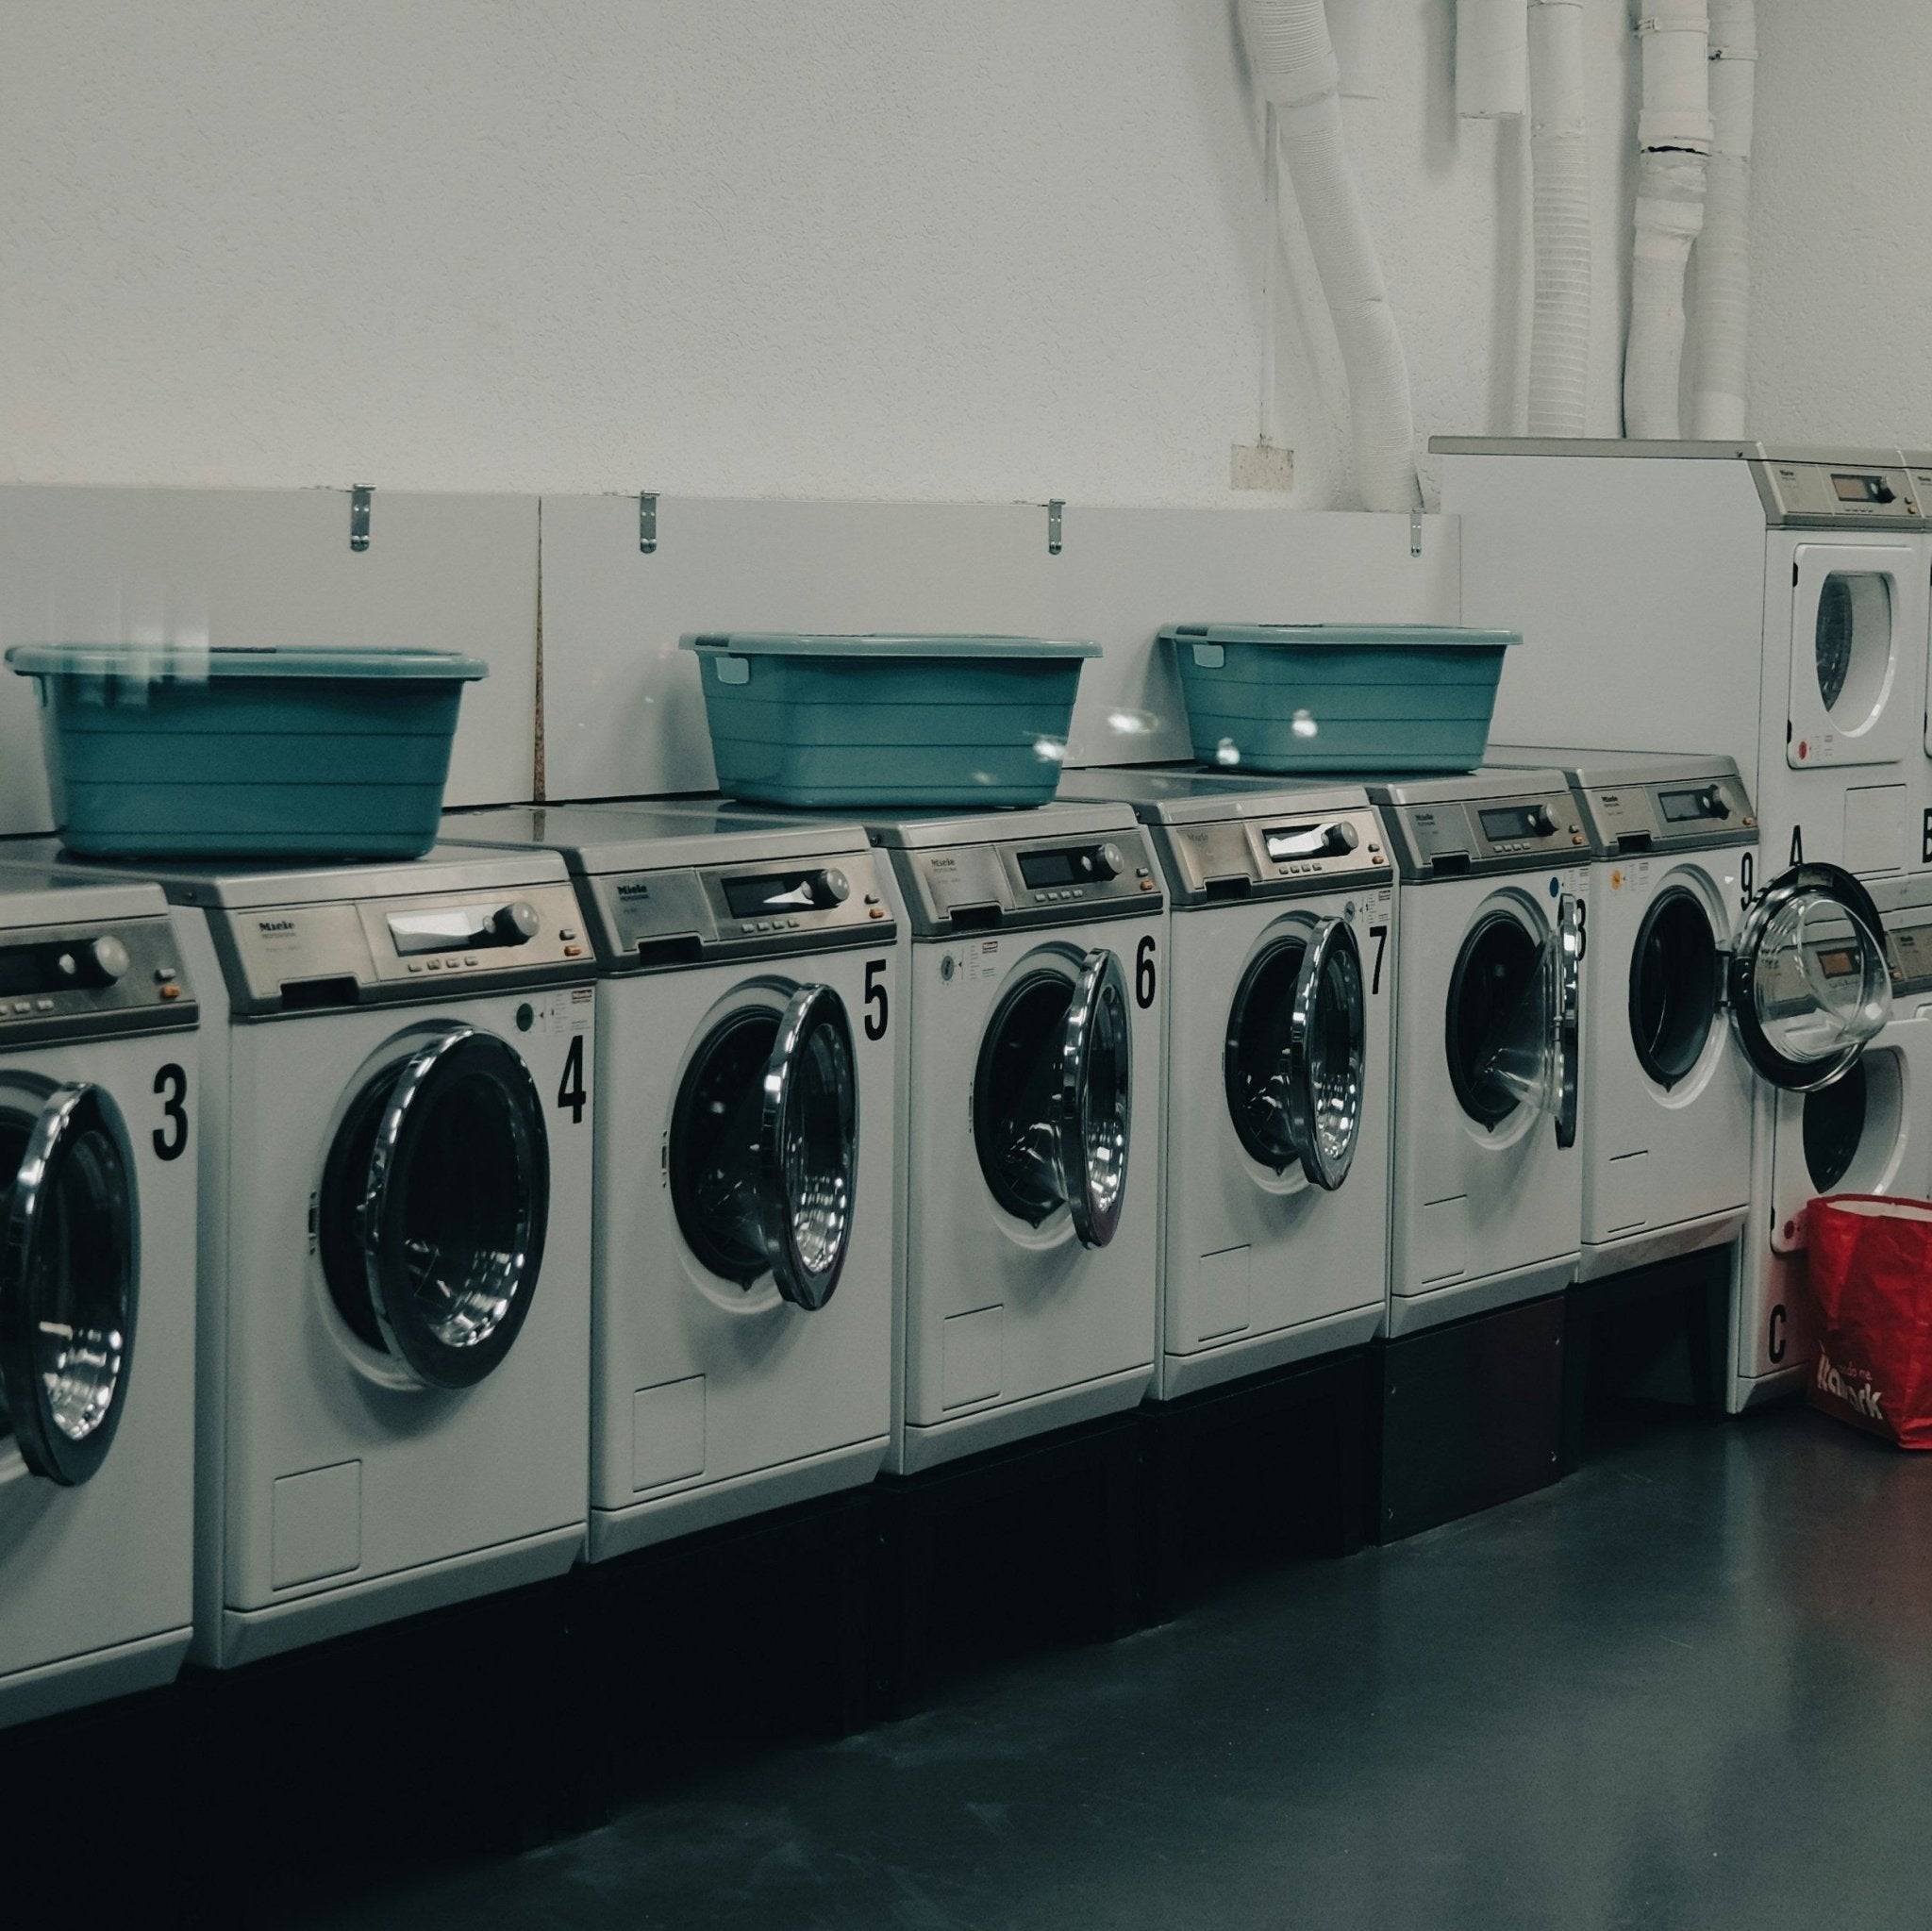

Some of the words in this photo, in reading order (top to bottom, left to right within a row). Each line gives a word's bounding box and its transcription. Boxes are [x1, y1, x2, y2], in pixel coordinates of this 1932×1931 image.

[1789, 824, 1803, 867] A
[617, 884, 647, 894] Miele
[1740, 852, 1754, 912] 9
[258, 921, 295, 931] Miele
[1135, 935, 1156, 1009] 6
[1369, 924, 1388, 995] 7
[864, 958, 889, 1041] 5
[152, 1062, 189, 1161] 3
[558, 1035, 587, 1124] 4
[1769, 1304, 1787, 1364] C
